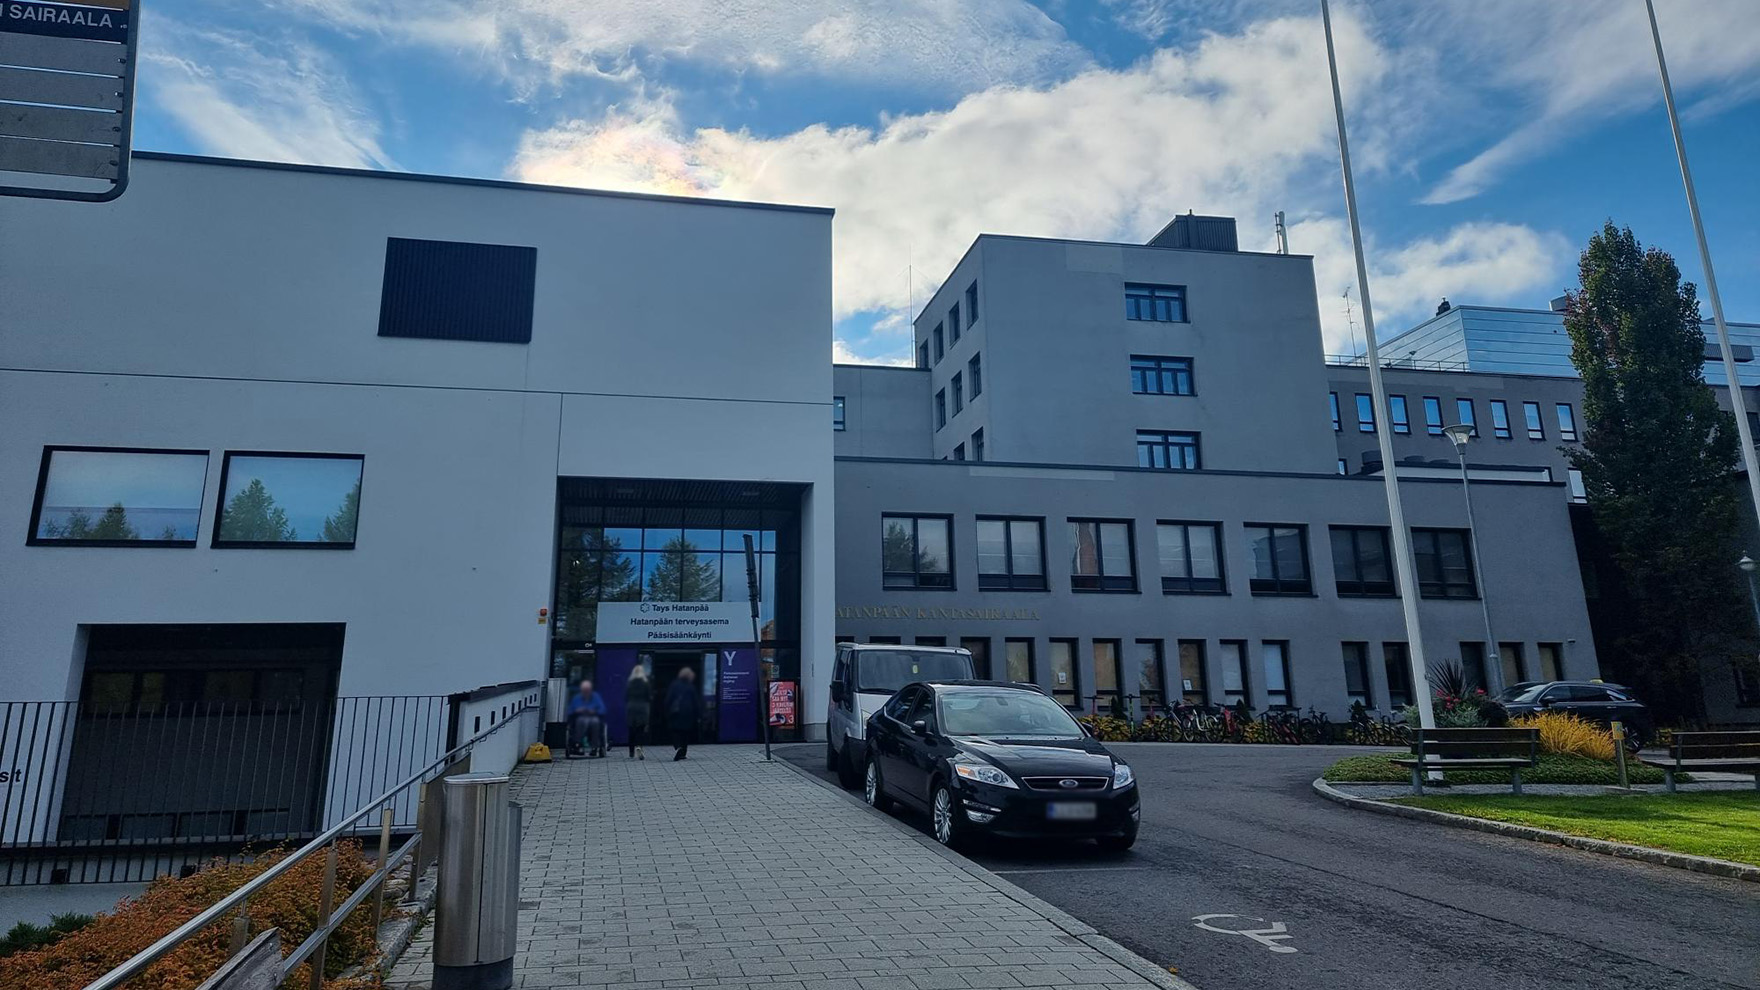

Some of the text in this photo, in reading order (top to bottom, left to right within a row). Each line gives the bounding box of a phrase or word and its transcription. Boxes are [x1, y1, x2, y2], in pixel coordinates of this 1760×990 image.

[9, 4, 113, 28] SAIRAALA
[652, 603, 709, 613] Tays Hatanpää
[630, 618, 729, 626] Hatanpään terveysasema
[647, 631, 712, 640] Pääsisäänkäynti
[724, 651, 736, 666] Y
[0, 769, 21, 784] st
